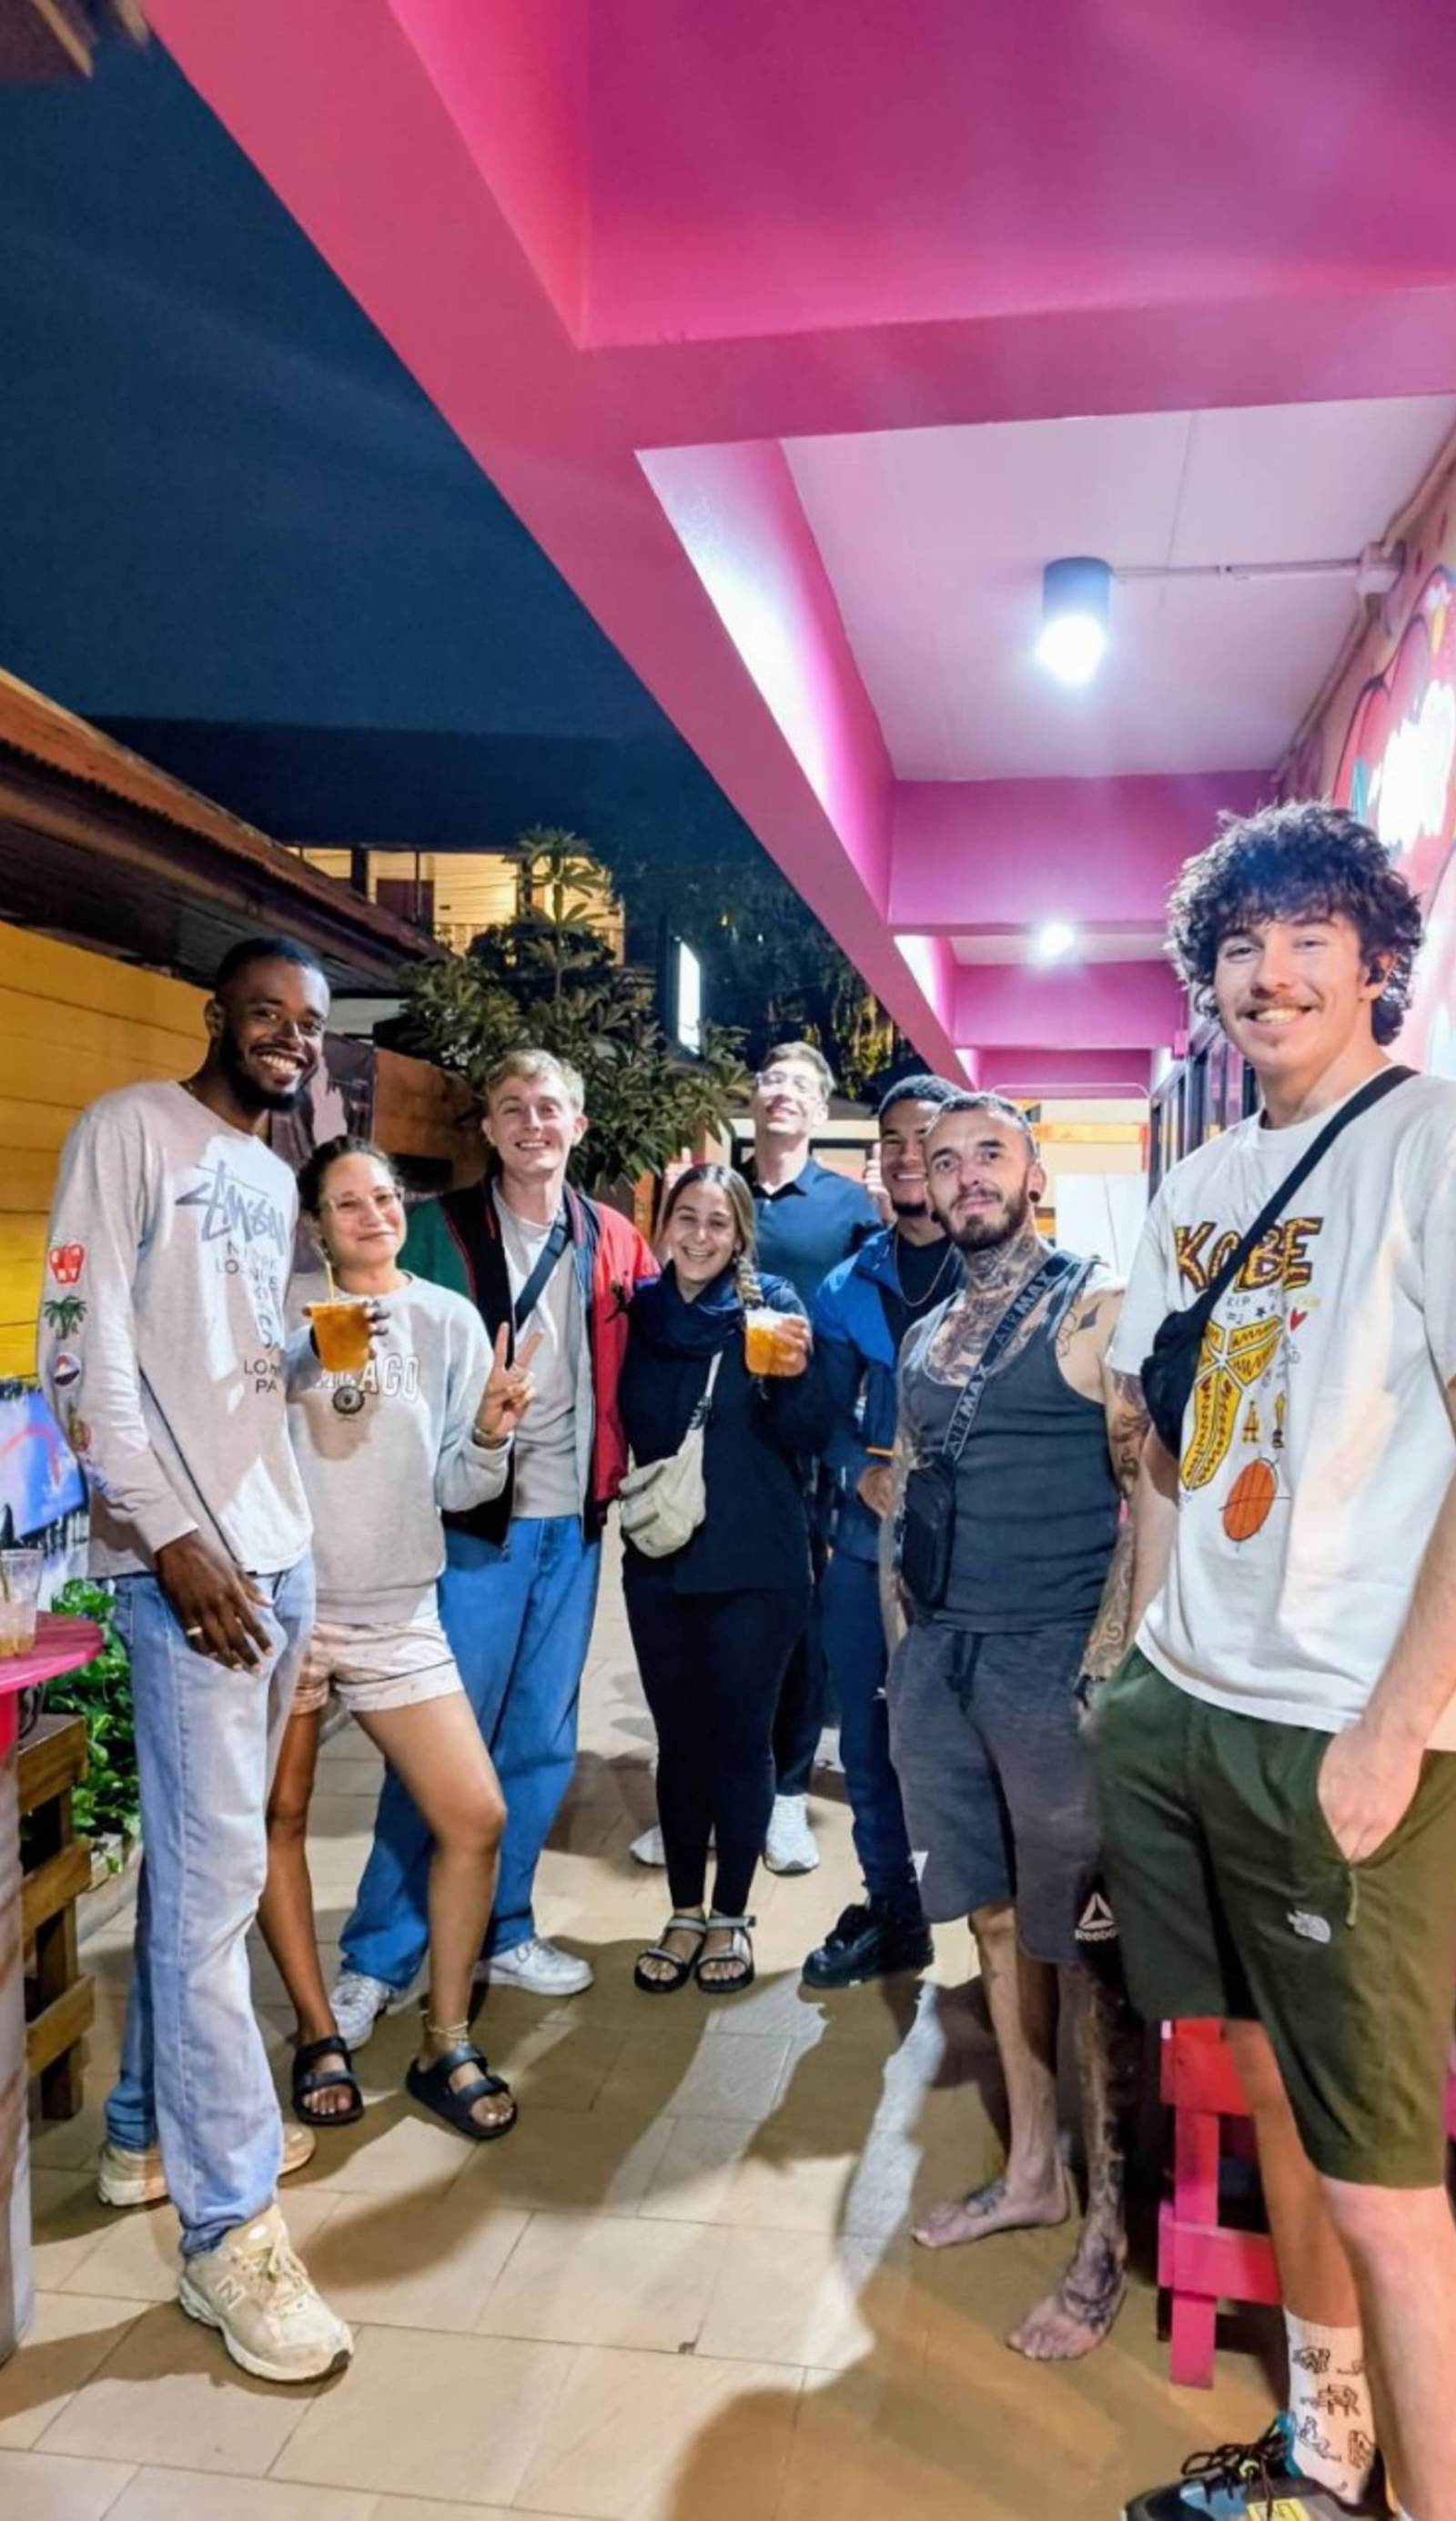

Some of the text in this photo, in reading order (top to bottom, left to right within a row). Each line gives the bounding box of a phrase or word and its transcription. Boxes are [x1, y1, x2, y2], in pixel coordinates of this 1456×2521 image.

[1012, 1270, 1047, 1316] MAX
[959, 1363, 990, 1419] MAX
[1075, 1929, 1117, 1941] Reebo
